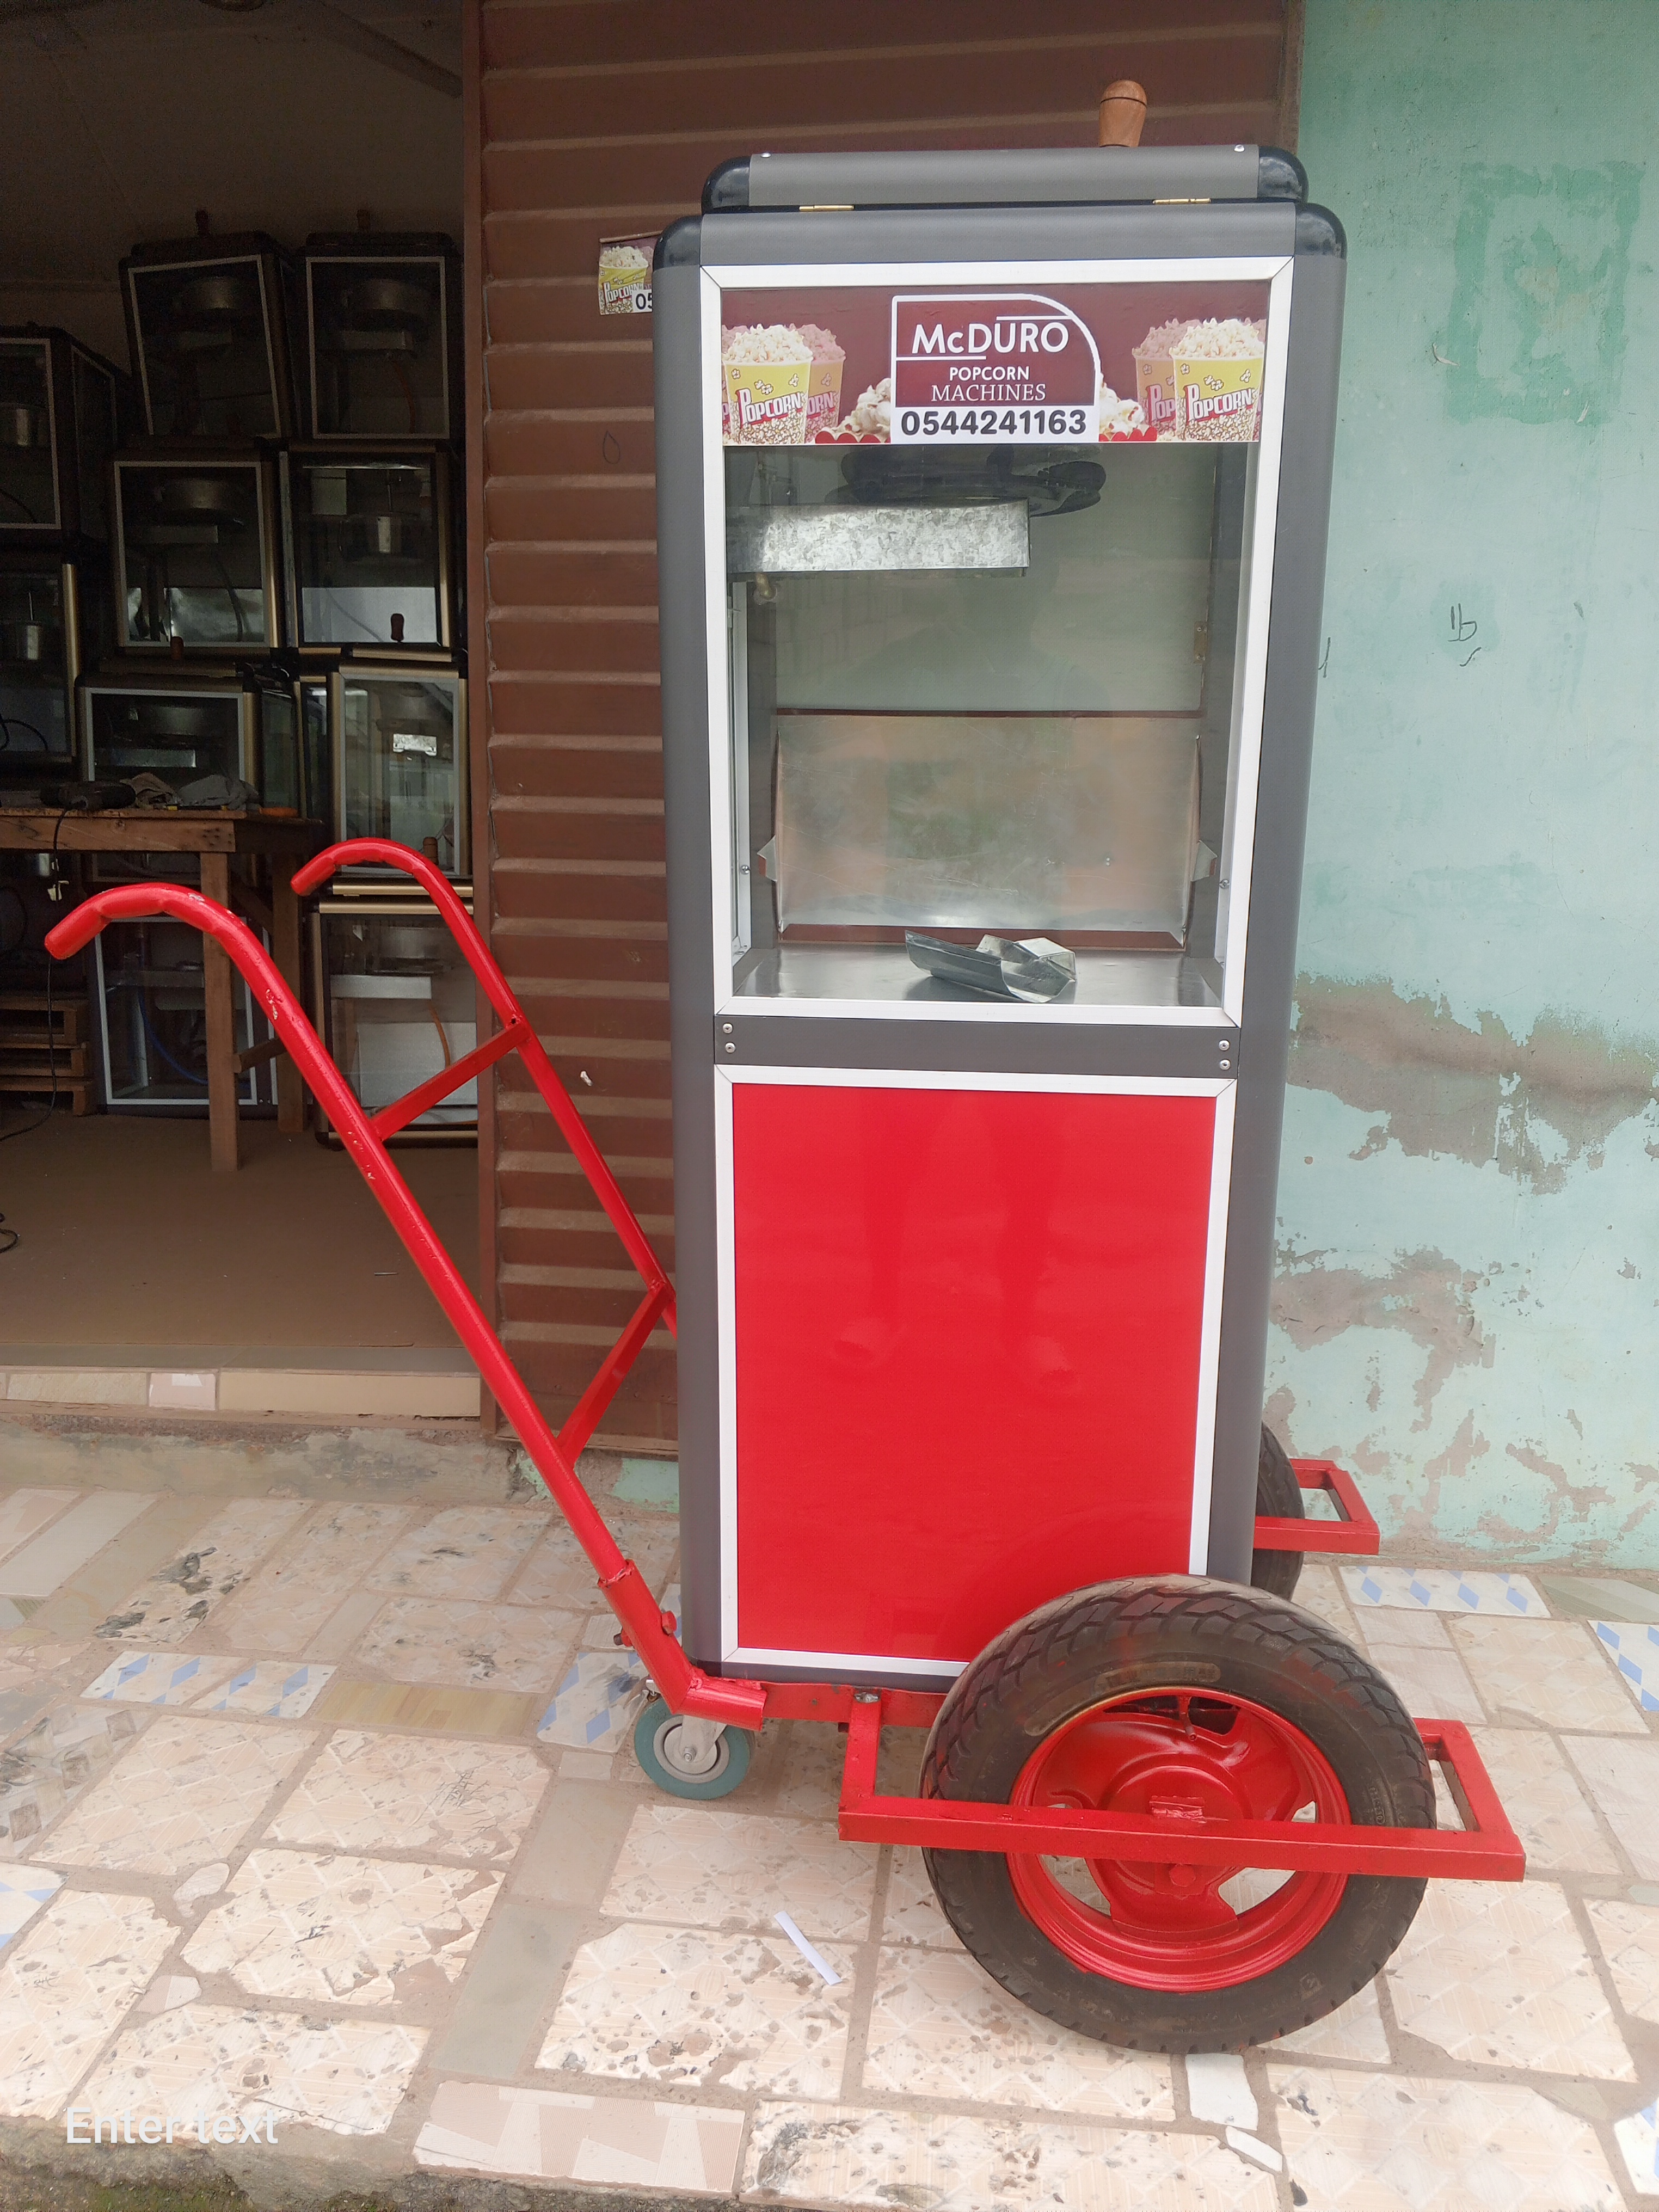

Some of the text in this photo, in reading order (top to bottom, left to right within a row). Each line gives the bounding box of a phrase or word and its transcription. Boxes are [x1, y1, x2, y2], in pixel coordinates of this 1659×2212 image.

[912, 322, 1069, 354] McDURO
[949, 366, 1029, 381] POPCORN
[737, 388, 803, 426] POPCORN
[931, 384, 1046, 402] MACHINES
[1185, 384, 1253, 423] POPCORN
[901, 410, 1086, 435] 0544241163
